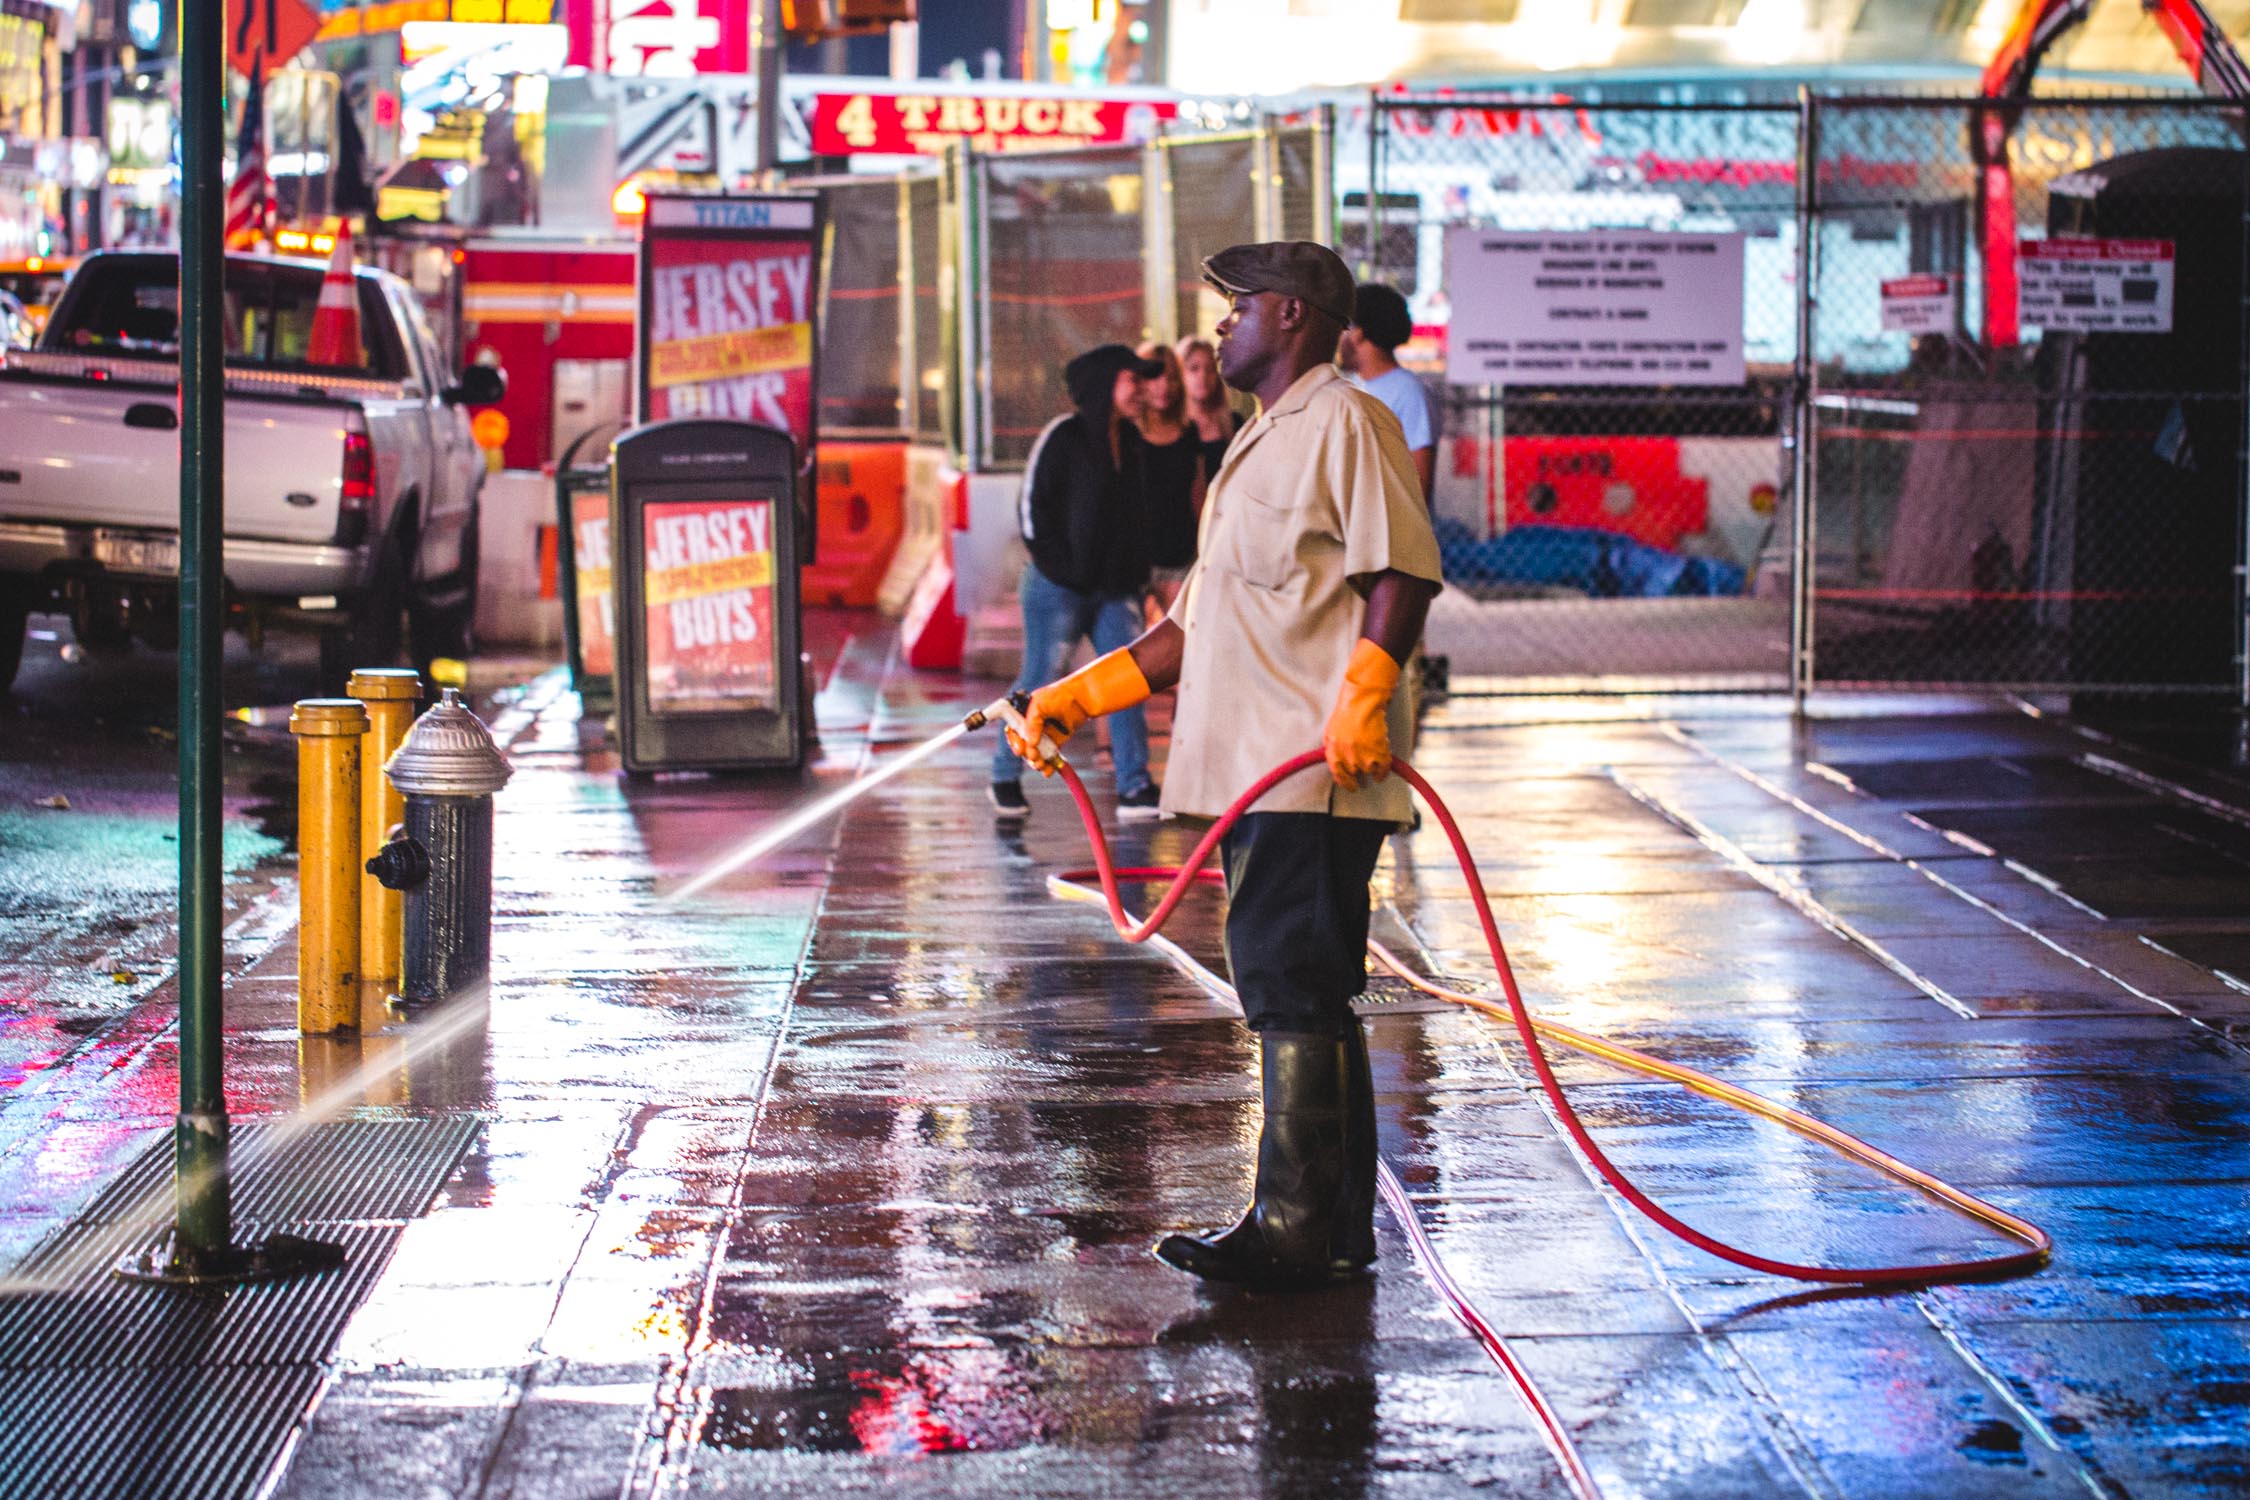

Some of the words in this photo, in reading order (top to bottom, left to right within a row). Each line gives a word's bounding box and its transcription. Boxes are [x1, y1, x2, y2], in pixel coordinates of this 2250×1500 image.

[835, 96, 878, 146] 4
[895, 96, 1106, 136] TRUCK
[694, 203, 771, 226] TITAN
[2060, 262, 2122, 277] Stairway
[652, 255, 812, 344] JERSEY
[650, 505, 770, 573] JERSEY
[670, 588, 757, 650] BOYS
